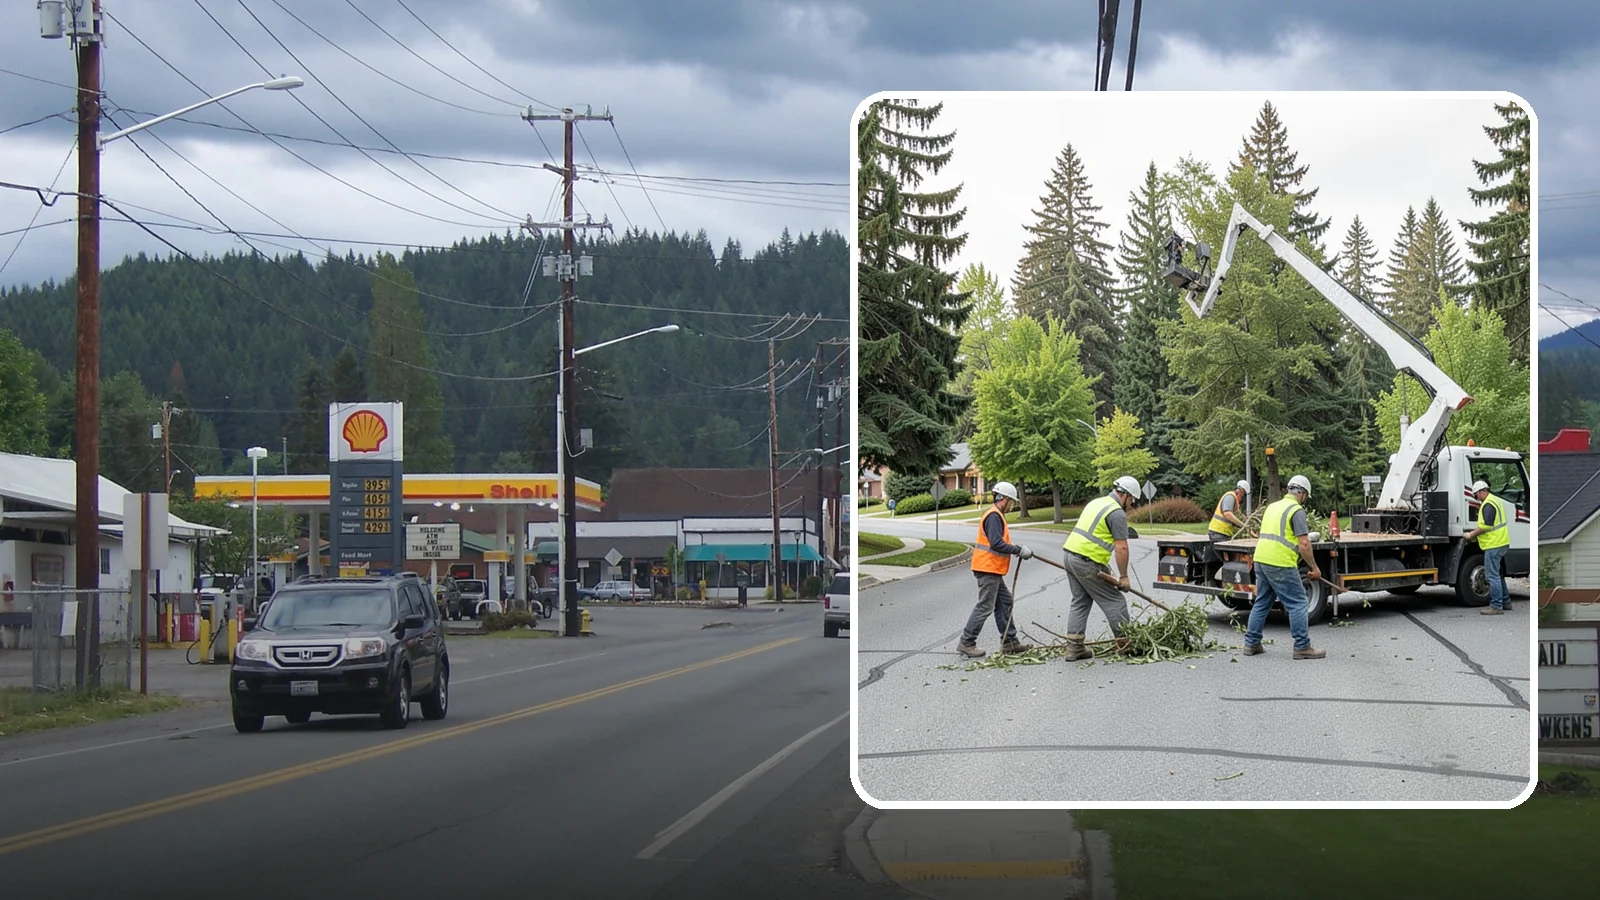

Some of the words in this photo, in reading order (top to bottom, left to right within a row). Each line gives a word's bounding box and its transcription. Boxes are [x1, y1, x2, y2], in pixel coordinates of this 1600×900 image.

[365, 480, 383, 490] 395
[365, 494, 383, 504] 405
[365, 508, 383, 518] 415
[366, 522, 383, 532] 429
